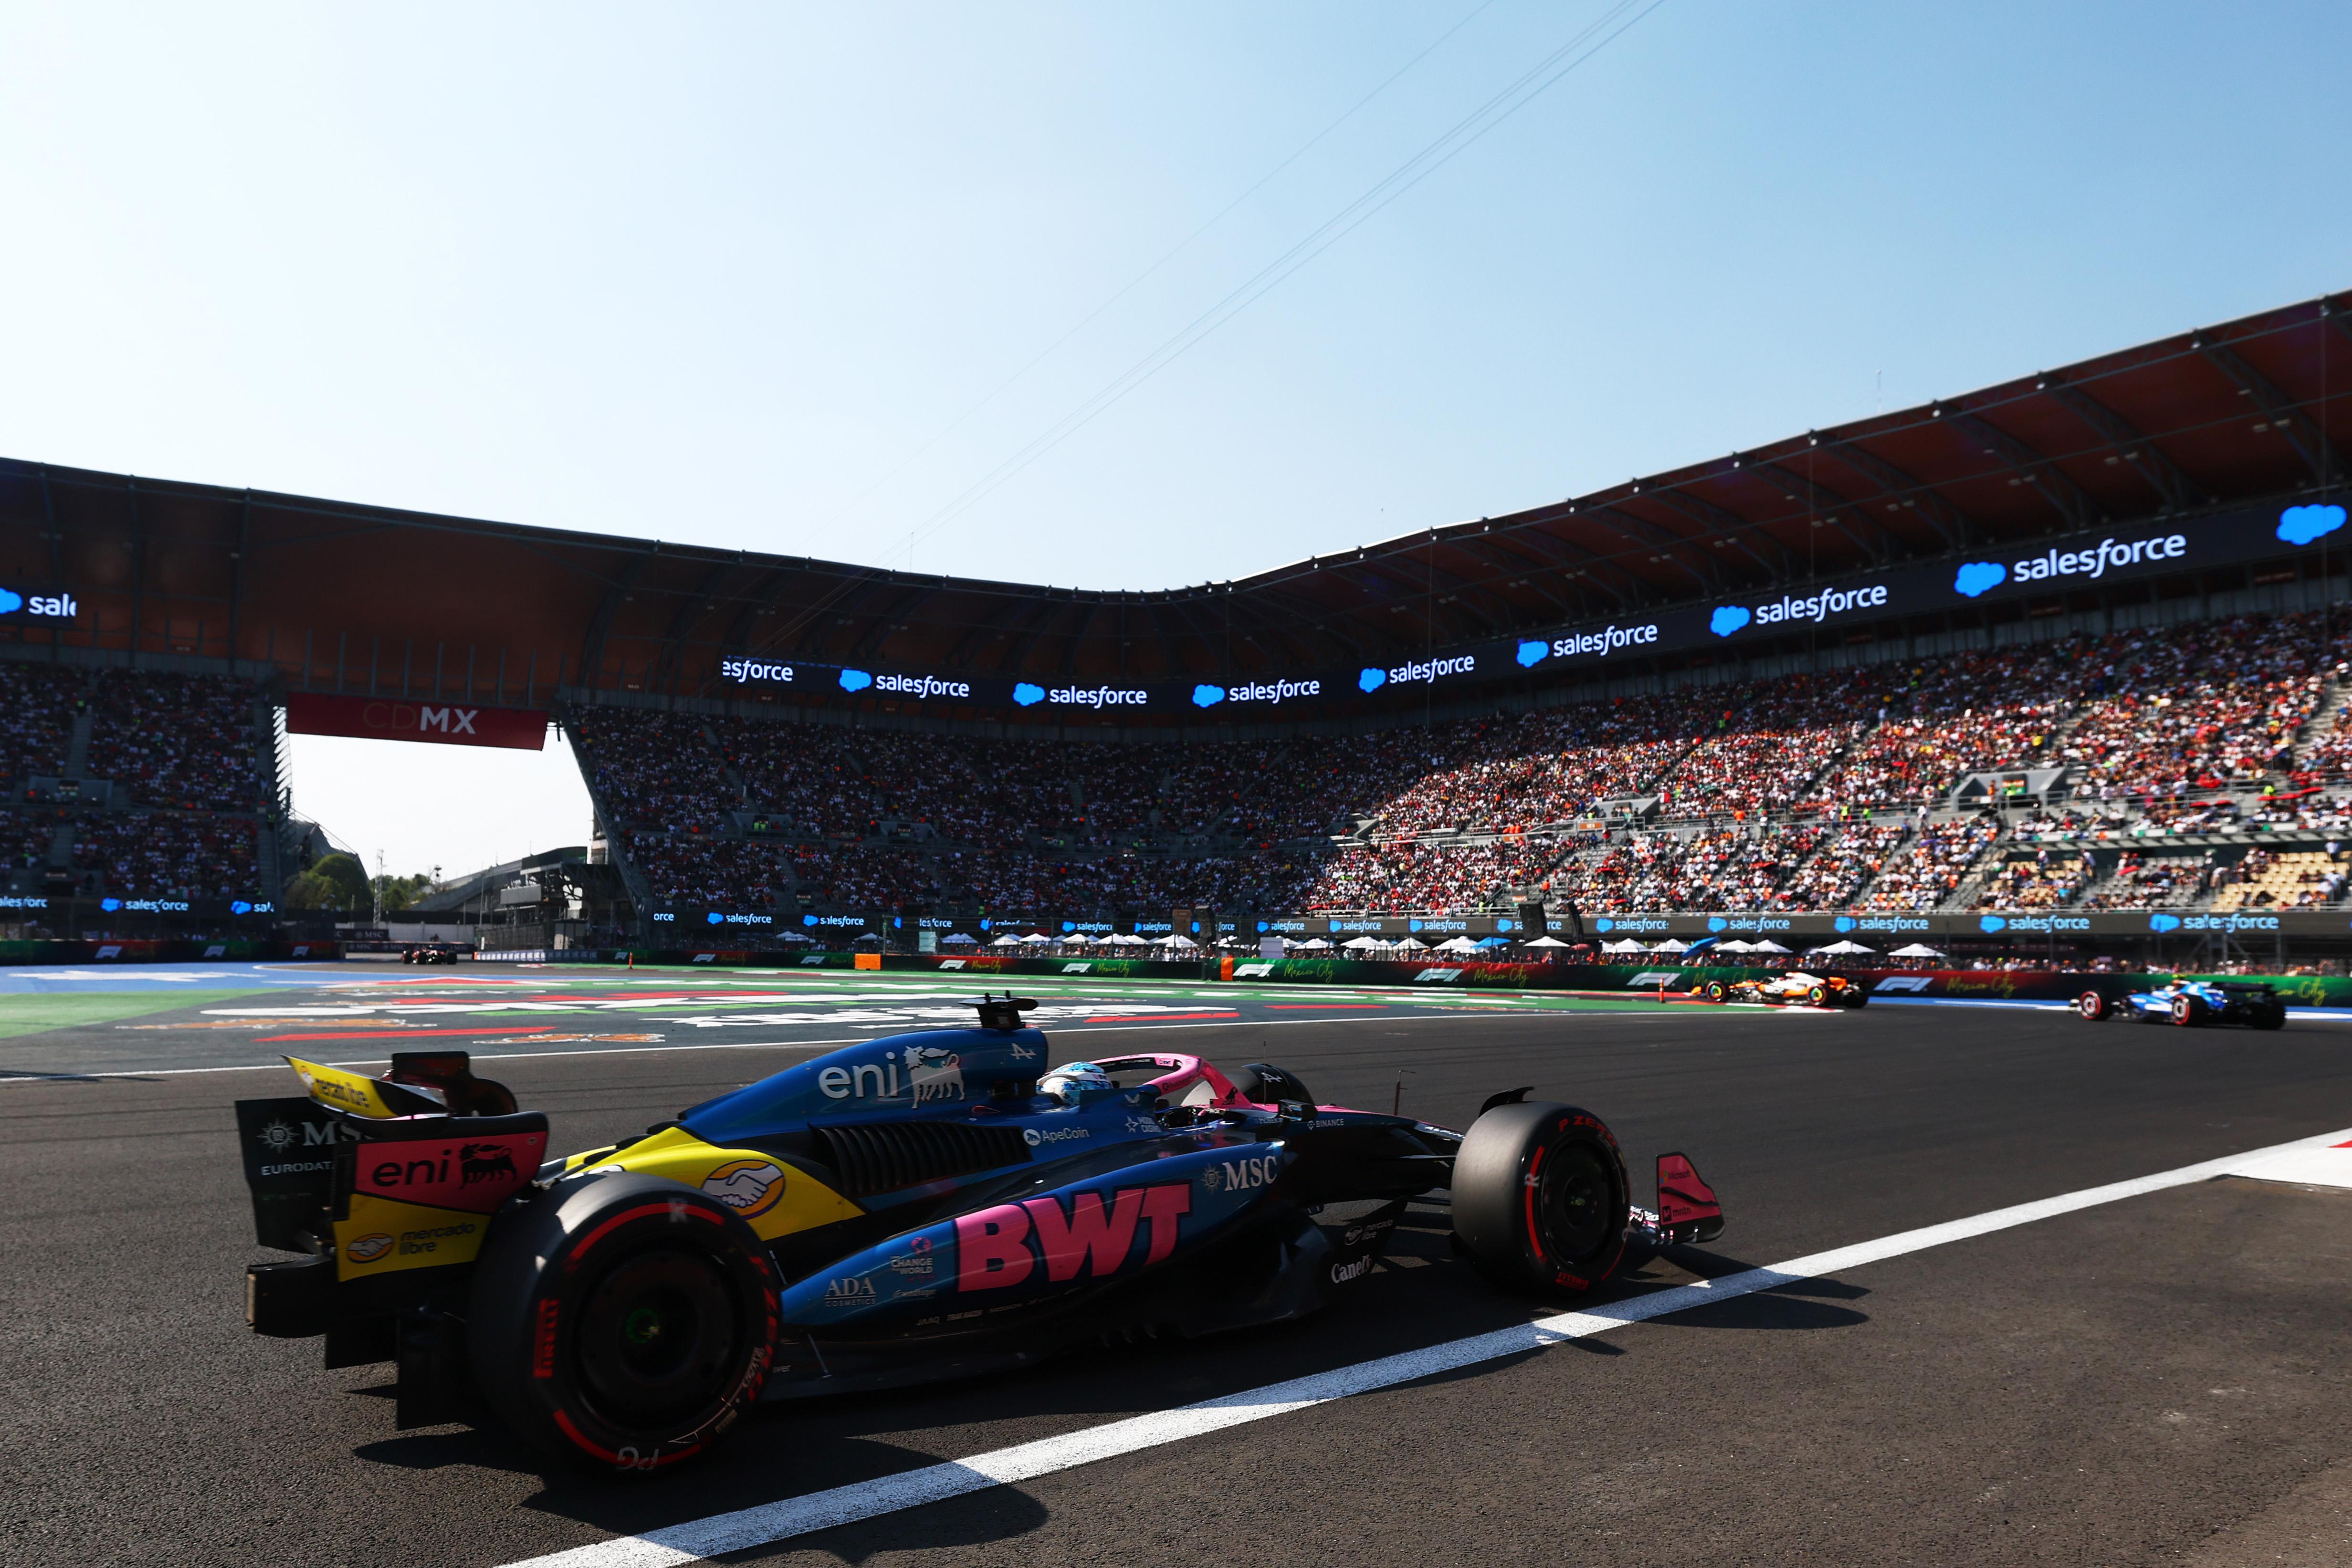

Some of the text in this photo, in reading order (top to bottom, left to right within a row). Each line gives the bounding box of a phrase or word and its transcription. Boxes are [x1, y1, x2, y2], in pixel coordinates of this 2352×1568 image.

[2014, 534, 2186, 578] salesforce
[1756, 585, 1888, 625] salesforce
[1553, 624, 1658, 657] salesforce
[1389, 655, 1475, 684] salesforce
[875, 674, 970, 699] salesforce
[1229, 679, 1320, 704] salesforce
[1050, 685, 1147, 709] salesforce
[125, 898, 189, 913] salesforce
[725, 912, 772, 926] salesforce
[819, 915, 865, 928] salesforce
[1142, 921, 1173, 932] salesforce
[1270, 920, 1305, 933] salesforce
[1343, 920, 1382, 933] salesforce
[1424, 919, 1467, 933] salesforce
[1729, 917, 1790, 933] salesforce
[1859, 916, 1930, 933] salesforce
[2008, 914, 2090, 934] salesforce
[2183, 913, 2279, 934] salesforce
[1283, 964, 1316, 978] Mexico
[1317, 960, 1336, 983] City
[1473, 968, 1508, 983] Mexico
[1509, 964, 1530, 987] City
[818, 1051, 899, 1099] eni
[300, 1120, 372, 1146] MS
[1315, 1118, 1345, 1128] BINANCE
[1041, 1127, 1090, 1144] ApeCoin
[261, 1161, 335, 1176] EURODAT
[373, 1149, 452, 1187] eni
[1221, 1155, 1278, 1192] MSC
[400, 1222, 475, 1242] mercado
[955, 1183, 1190, 1292] BWT
[399, 1241, 436, 1255] libre
[891, 1257, 934, 1268] CHANGE
[900, 1266, 934, 1275] WORLD
[824, 1276, 878, 1297] ADA
[825, 1298, 877, 1307] COSMETICS
